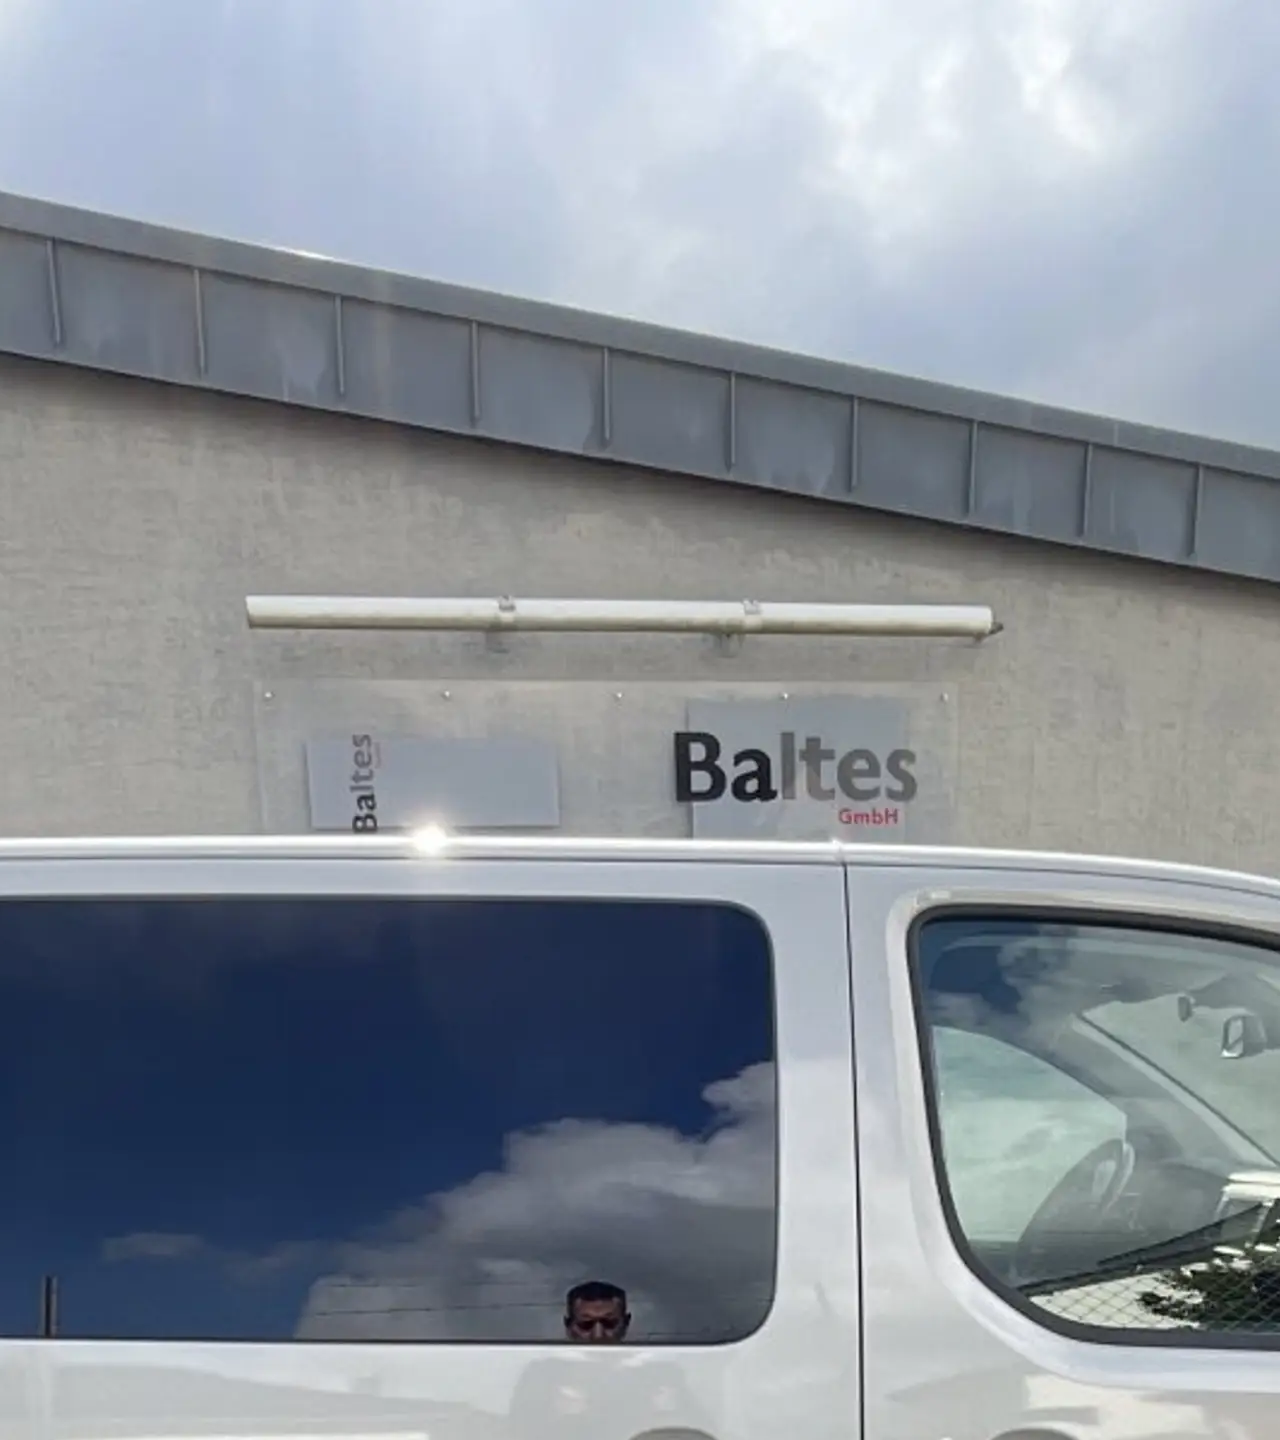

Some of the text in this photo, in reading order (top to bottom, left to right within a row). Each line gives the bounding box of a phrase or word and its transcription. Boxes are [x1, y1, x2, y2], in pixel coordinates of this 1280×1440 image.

[349, 734, 378, 834] Baltes
[673, 731, 918, 802] Baltes
[837, 807, 900, 825] GmbH
